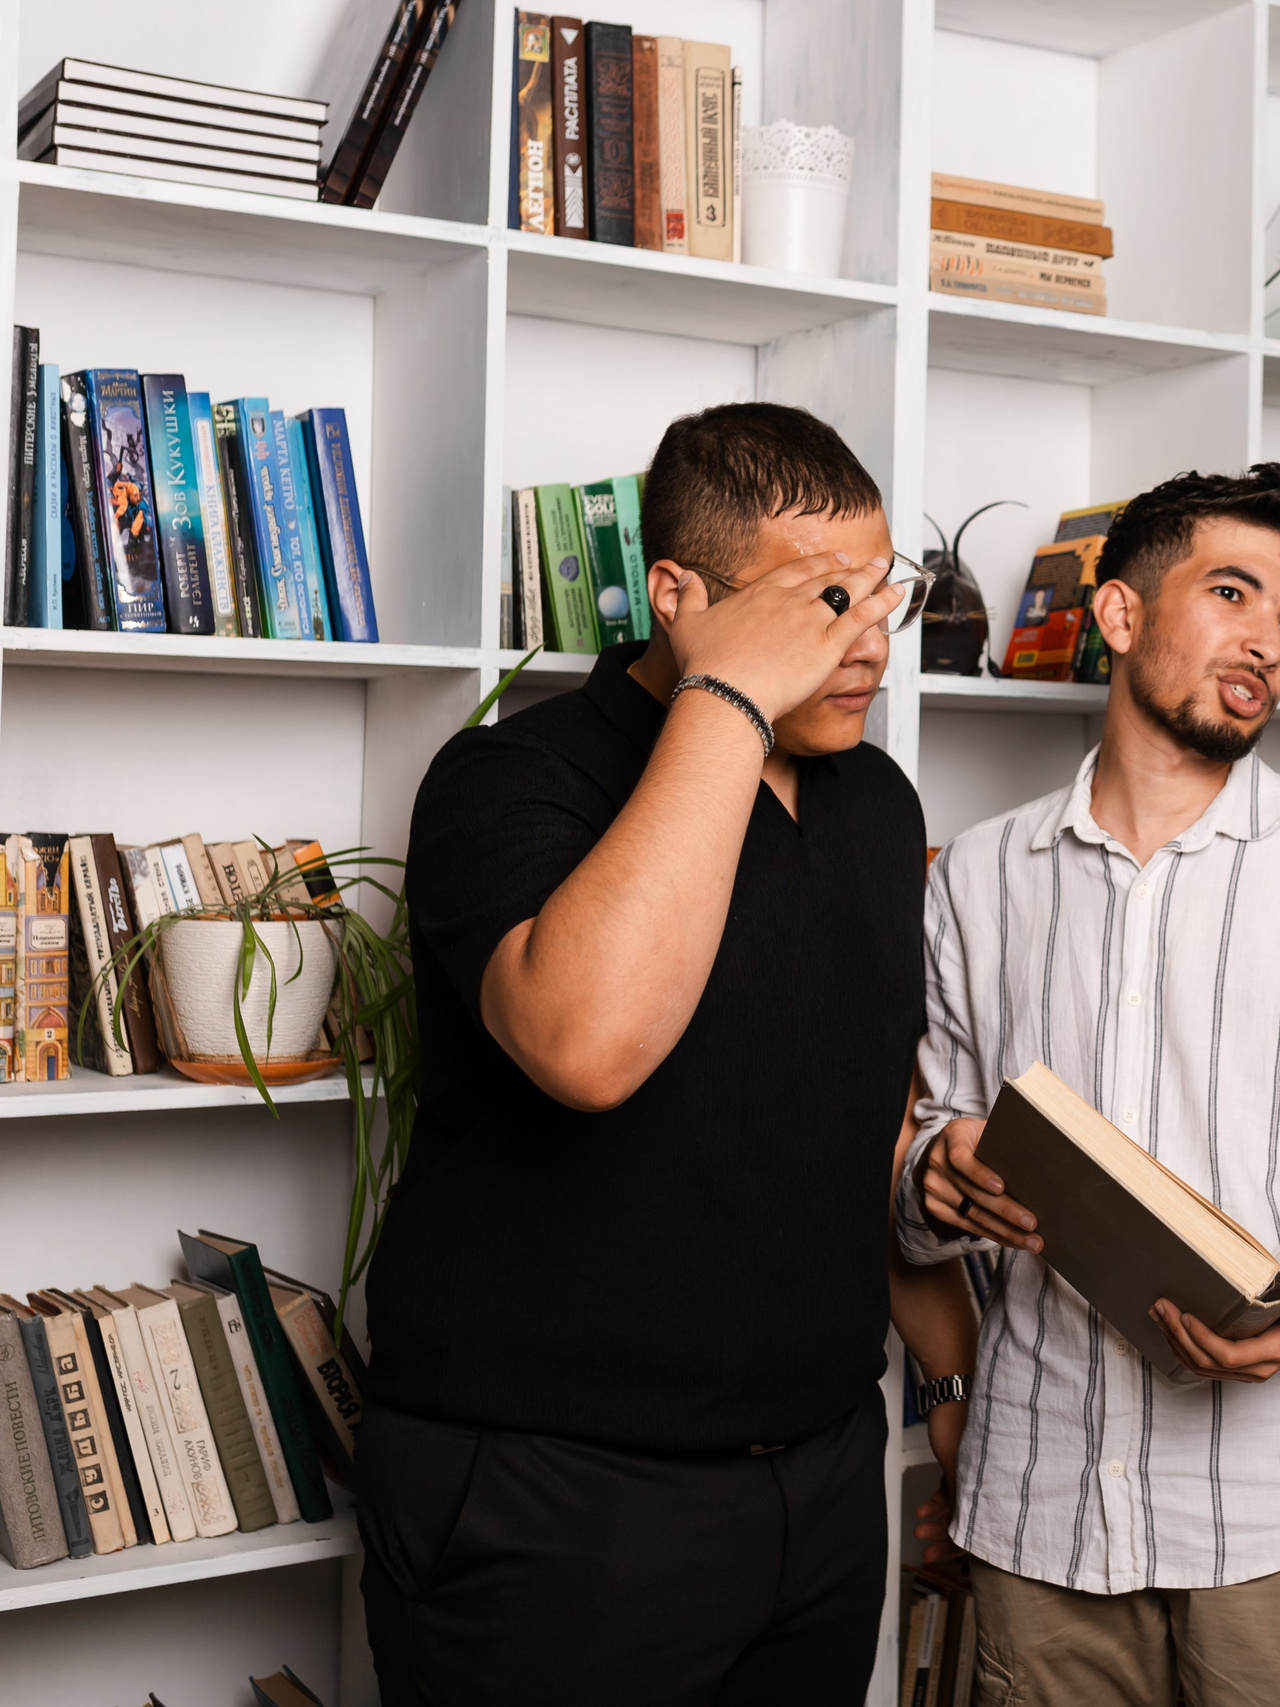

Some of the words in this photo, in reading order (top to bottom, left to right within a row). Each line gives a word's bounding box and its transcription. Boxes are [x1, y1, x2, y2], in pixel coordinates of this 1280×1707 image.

[562, 56, 579, 139] РАСПЛАТА
[528, 138, 544, 230] ЛЕГИОН
[23, 401, 36, 464] ПИТЕРСКИЕ
[274, 418, 288, 465] МАРТА
[205, 484, 220, 528] КНИГА
[280, 467, 294, 510] КЕТРО
[175, 551, 189, 598] РОБЕРТ
[207, 530, 231, 609] БЛАЖЕНСТВ
[293, 560, 303, 582] КТО
[128, 602, 154, 613] ПИР
[316, 1358, 360, 1420] ВТОРАЯ
[6, 1380, 29, 1452] ПОВЕСТИ
[51, 1425, 74, 1477] ЖАННА
[183, 1438, 202, 1480] АХУНОВ
[195, 1439, 212, 1472] ГАРИФ
[18, 1452, 47, 1544] ЛИТОВСКИЕ
